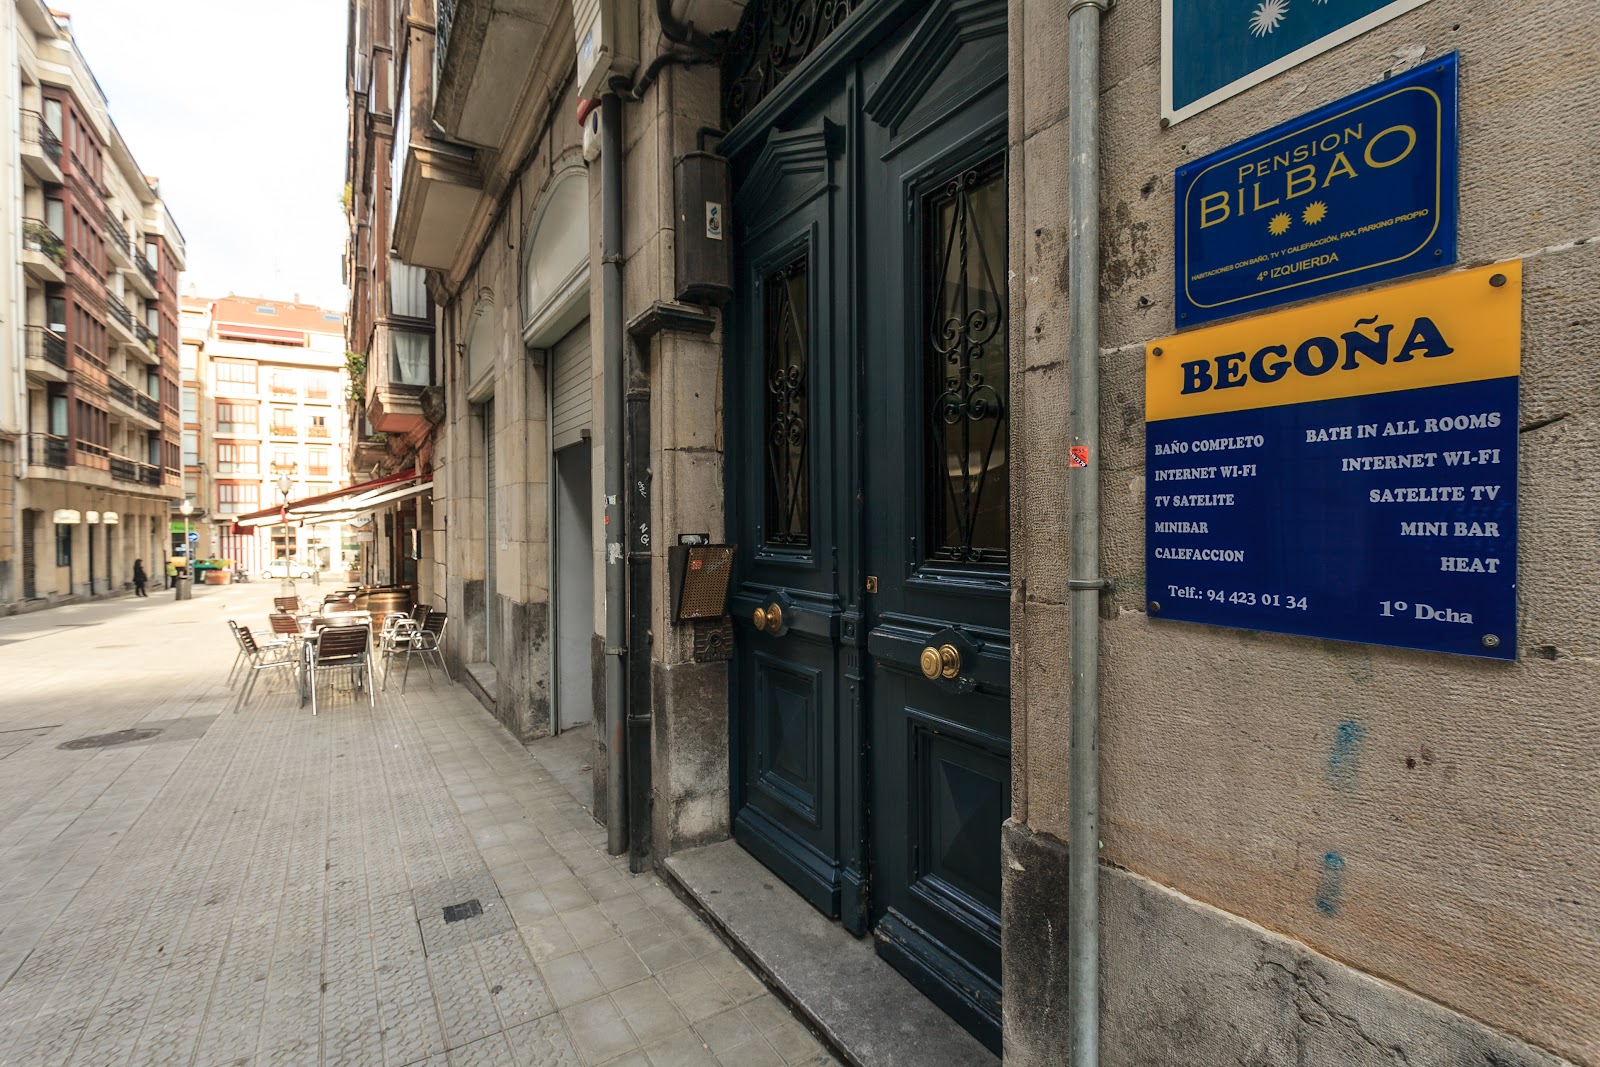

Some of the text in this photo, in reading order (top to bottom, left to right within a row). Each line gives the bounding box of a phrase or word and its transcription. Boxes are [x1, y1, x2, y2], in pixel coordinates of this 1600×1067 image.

[1238, 123, 1363, 184] PENSION
[1200, 124, 1417, 229] BILBAO
[1192, 265, 1234, 281] HABITACIONES
[1235, 261, 1249, 270] CON
[1340, 229, 1357, 240] FAX,
[1358, 218, 1394, 234] PARKING
[1395, 209, 1428, 224] PROPIO
[1271, 252, 1338, 278] IZQUIERDA
[1181, 315, 1454, 395] BEGOÑA
[1306, 412, 1501, 442] BATH IN ALL ROOMS
[1155, 435, 1264, 455] BAÑO COMPLETO
[1342, 449, 1500, 471] INTERNET WI-FI
[1155, 465, 1256, 481] INTERNET WI-FI
[1155, 494, 1234, 507] TV SATELITE
[1370, 486, 1501, 502] SATELITE TV
[1155, 522, 1208, 533] MINIBAR
[1401, 522, 1500, 537] MINI BAR
[1155, 548, 1244, 562] CALEFACCION
[1441, 557, 1500, 573] HEAT
[1168, 585, 1307, 610] Telf.: 94 423 01 34
[1415, 604, 1473, 624] Dcha
